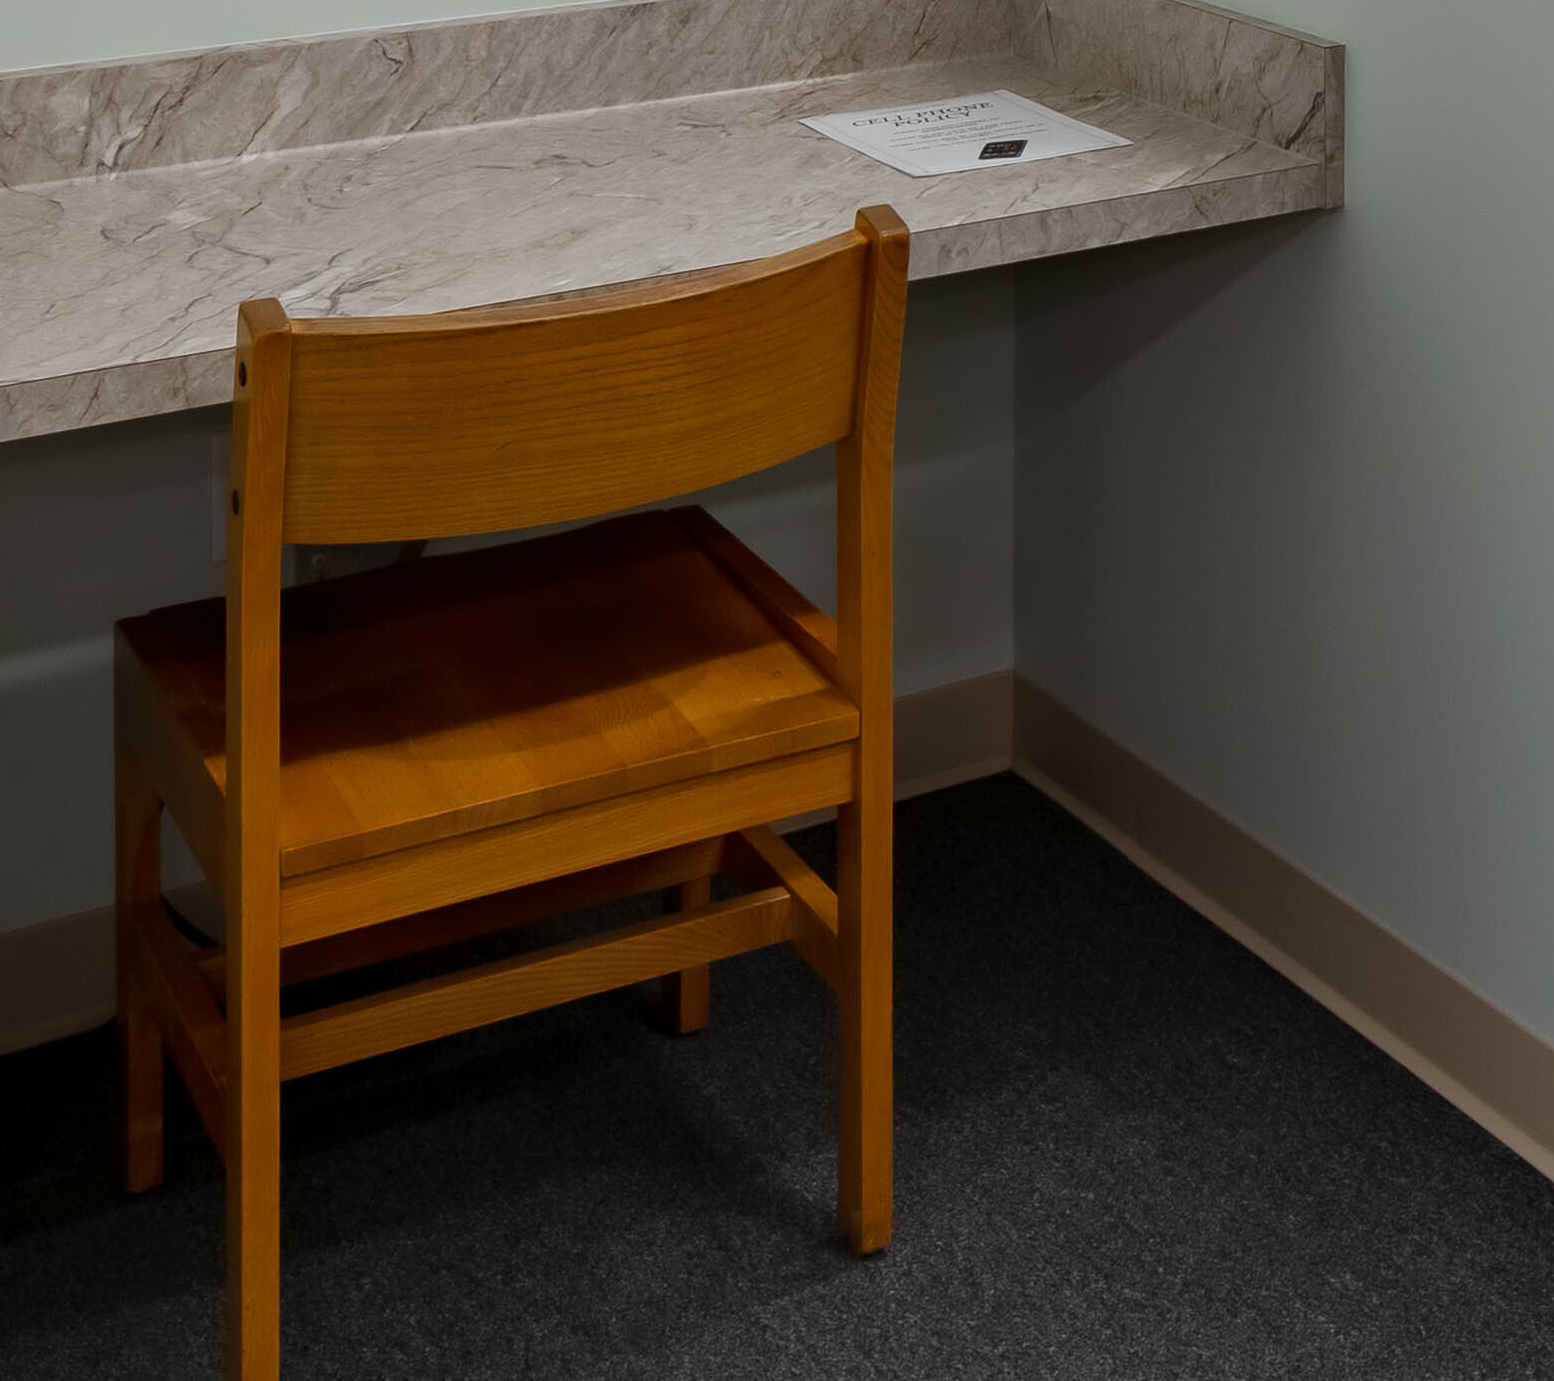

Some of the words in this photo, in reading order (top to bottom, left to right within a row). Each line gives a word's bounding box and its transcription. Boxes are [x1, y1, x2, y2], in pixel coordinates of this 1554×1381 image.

[851, 114, 909, 127] CELL
[916, 102, 995, 118] PHONE
[893, 110, 971, 127] POLICY
